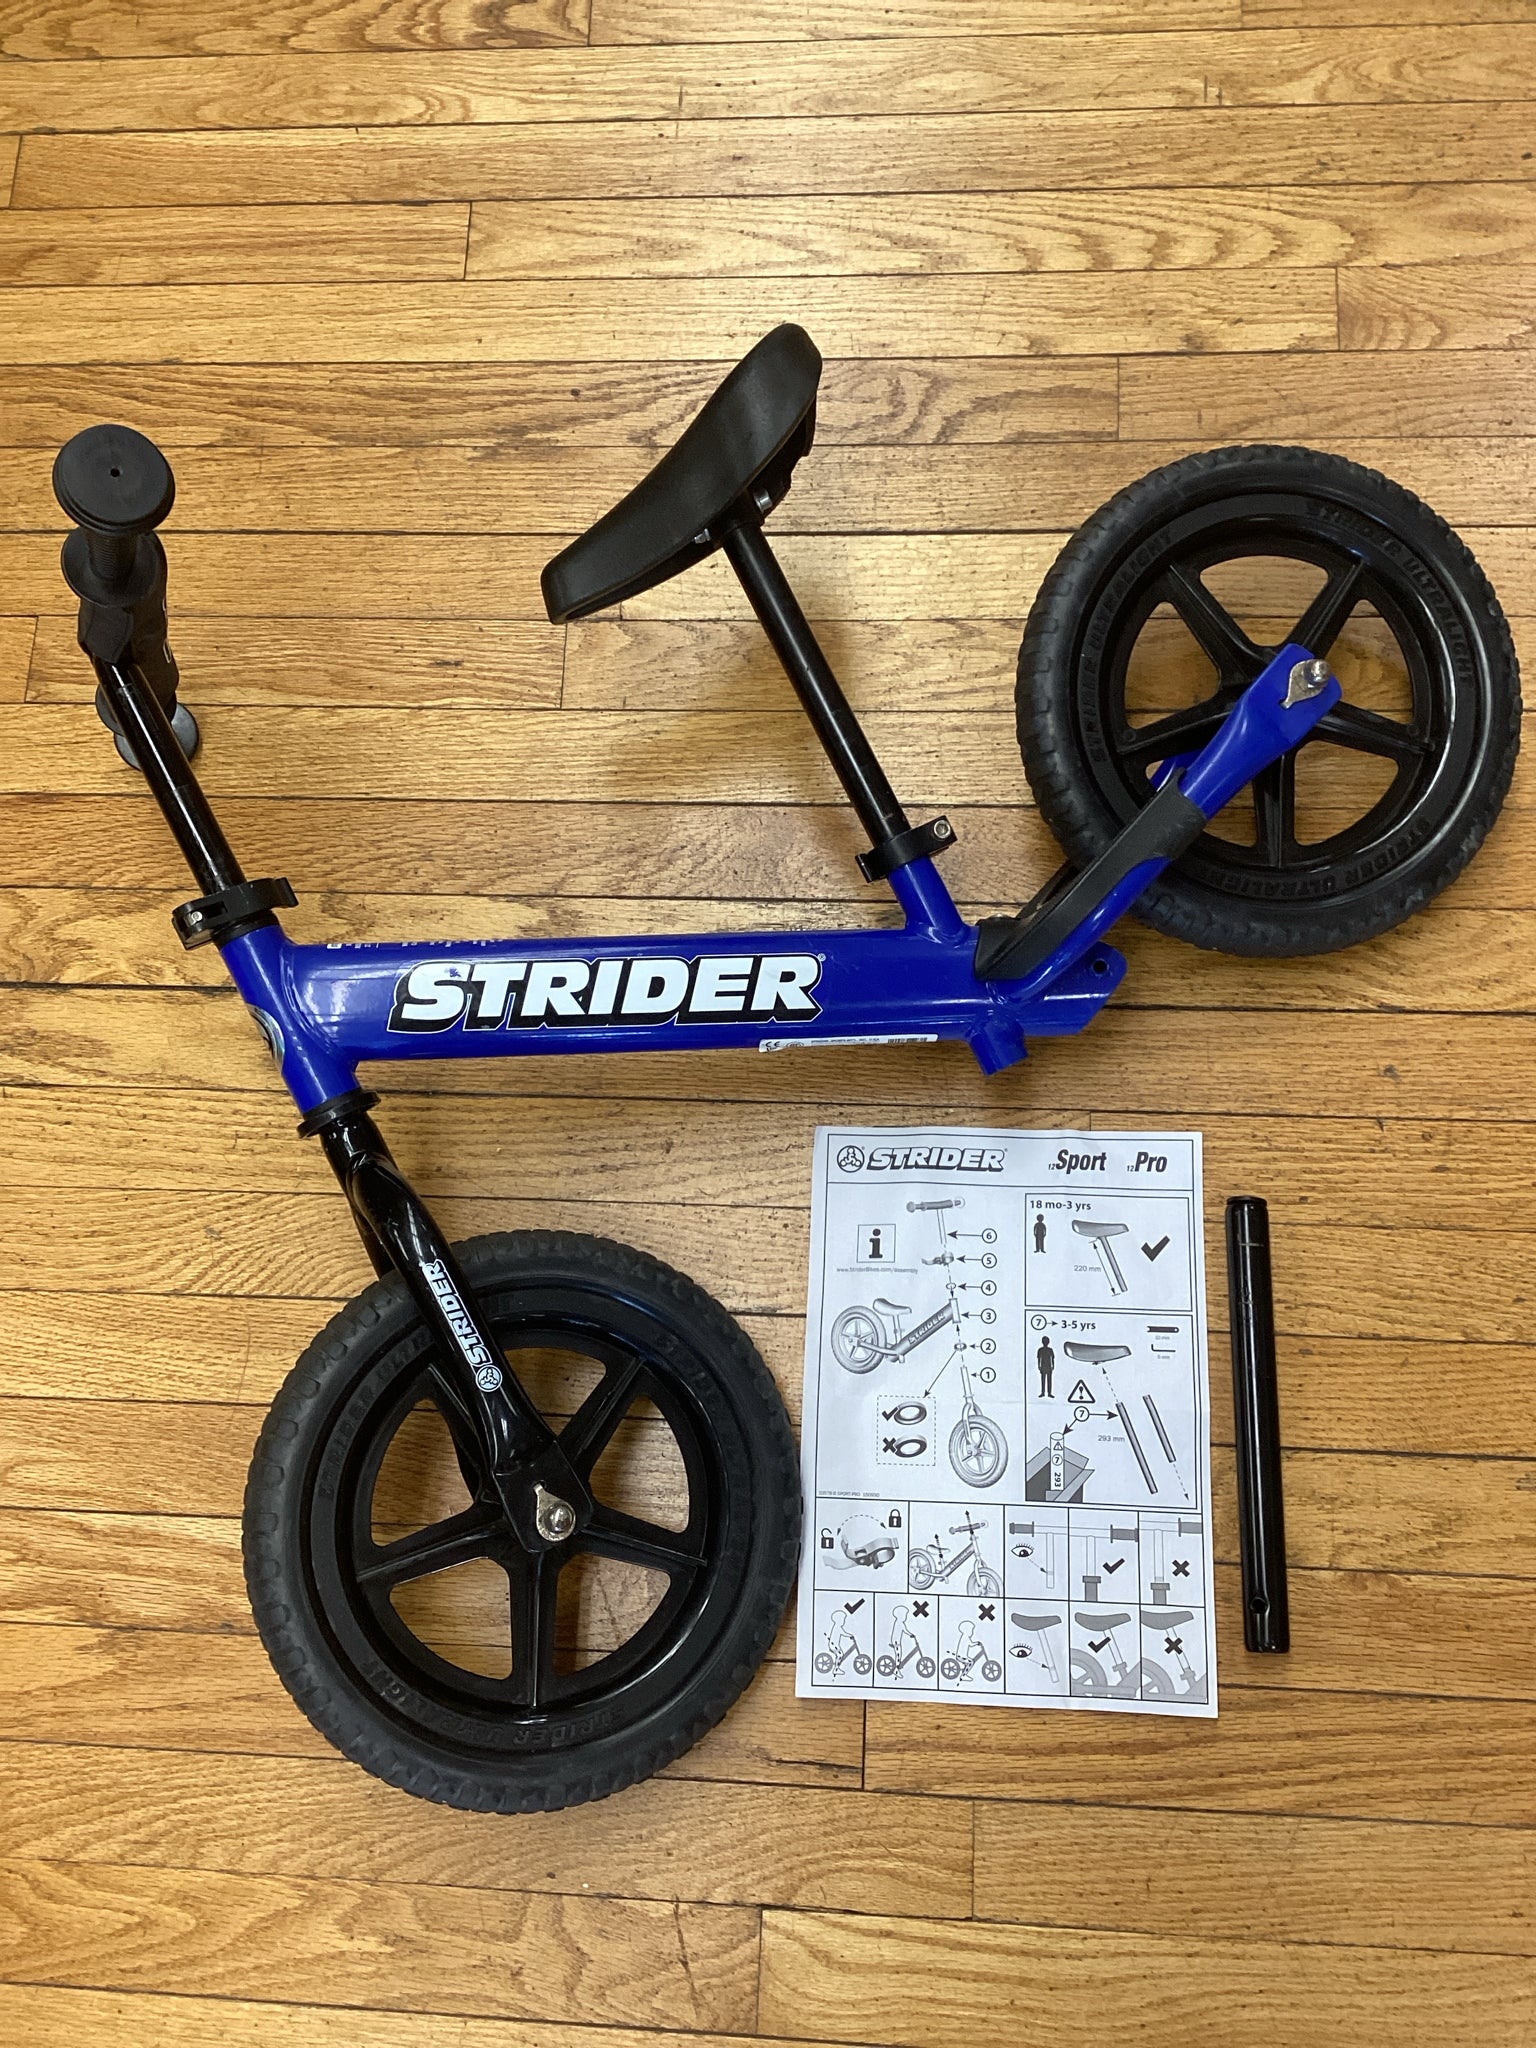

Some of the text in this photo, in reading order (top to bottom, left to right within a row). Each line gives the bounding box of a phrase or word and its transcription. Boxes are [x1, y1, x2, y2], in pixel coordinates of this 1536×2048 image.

[390, 954, 822, 1031] STRIDER
[867, 1147, 1005, 1172] STRIDER
[1030, 1200, 1091, 1212] 18 mo-3 yrs
[422, 1259, 493, 1366] STRIDER
[1061, 1320, 1078, 1329] 3-5
[1080, 1322, 1096, 1331] yrs
